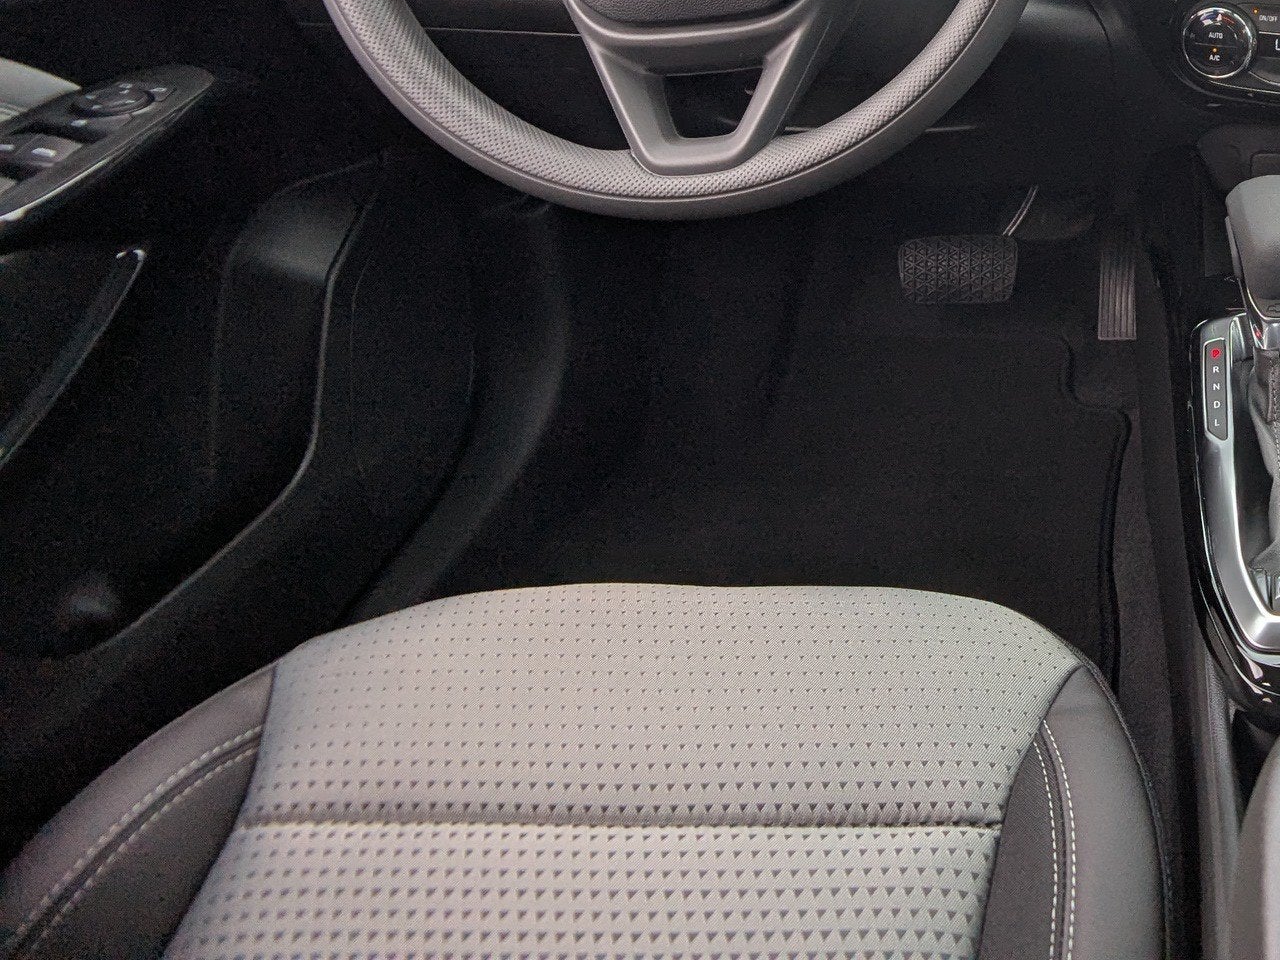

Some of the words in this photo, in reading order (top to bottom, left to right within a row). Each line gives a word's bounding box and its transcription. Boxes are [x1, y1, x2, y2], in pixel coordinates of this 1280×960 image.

[1259, 15, 1278, 23] ON/OFF
[1208, 32, 1223, 40] AUTO
[1211, 348, 1220, 358] P
[1212, 365, 1220, 374] R
[1212, 383, 1220, 391] N
[1213, 400, 1220, 409] D
[1214, 419, 1220, 427] L
